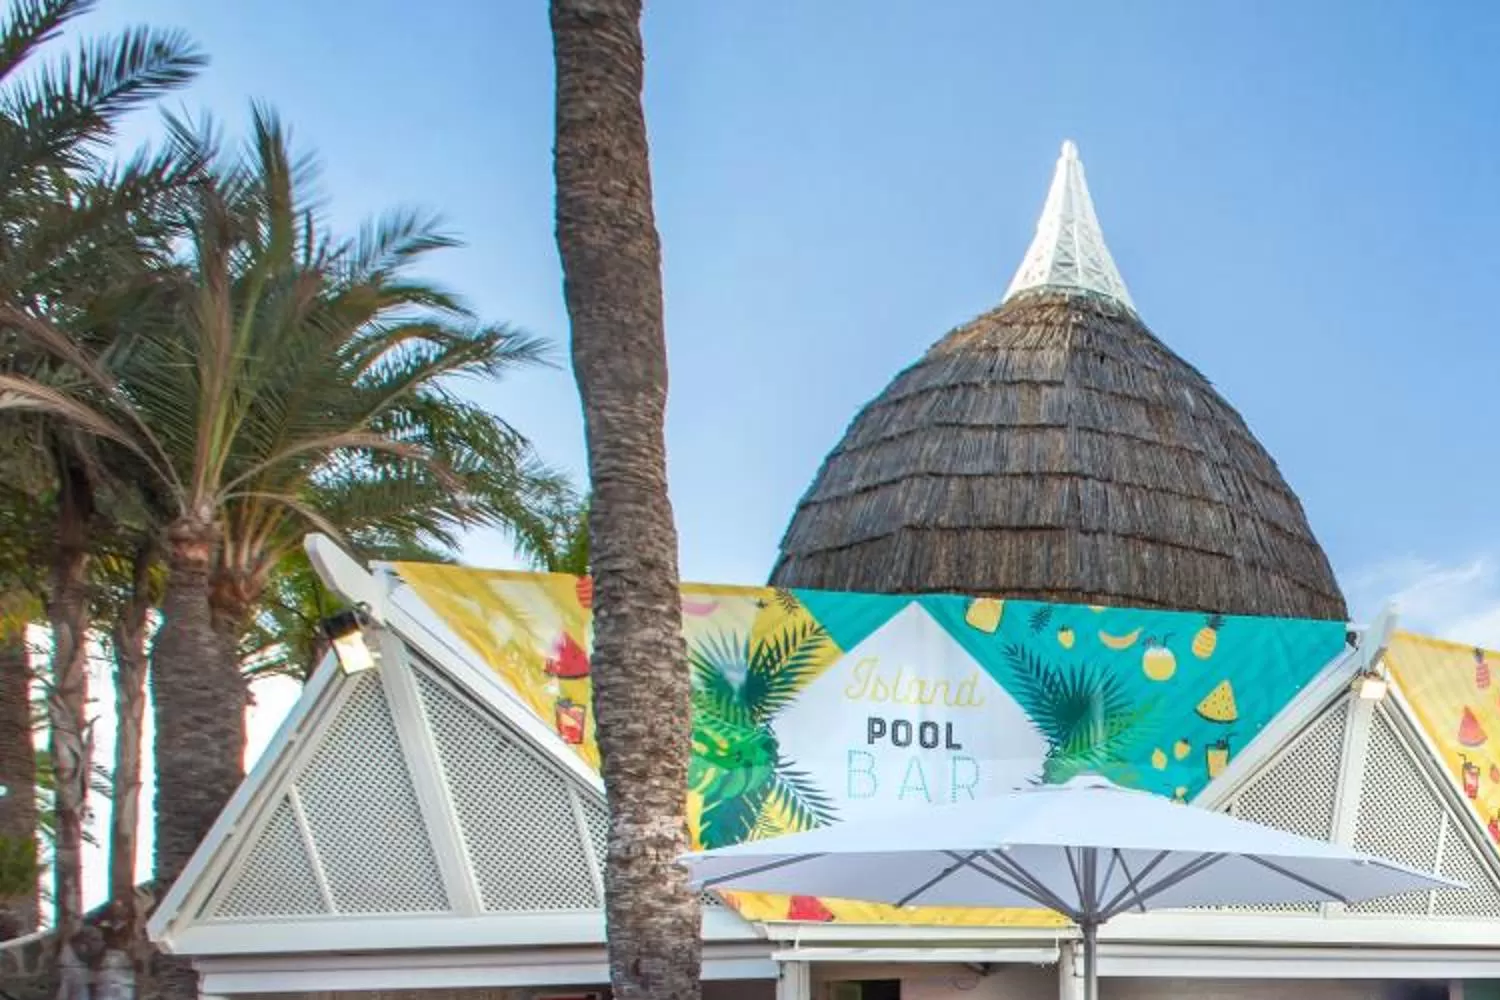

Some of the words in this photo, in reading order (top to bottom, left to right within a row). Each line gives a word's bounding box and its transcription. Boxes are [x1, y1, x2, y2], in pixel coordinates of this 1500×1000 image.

[845, 656, 985, 706] Island
[867, 716, 962, 750] POOL
[848, 749, 980, 802] BAR
